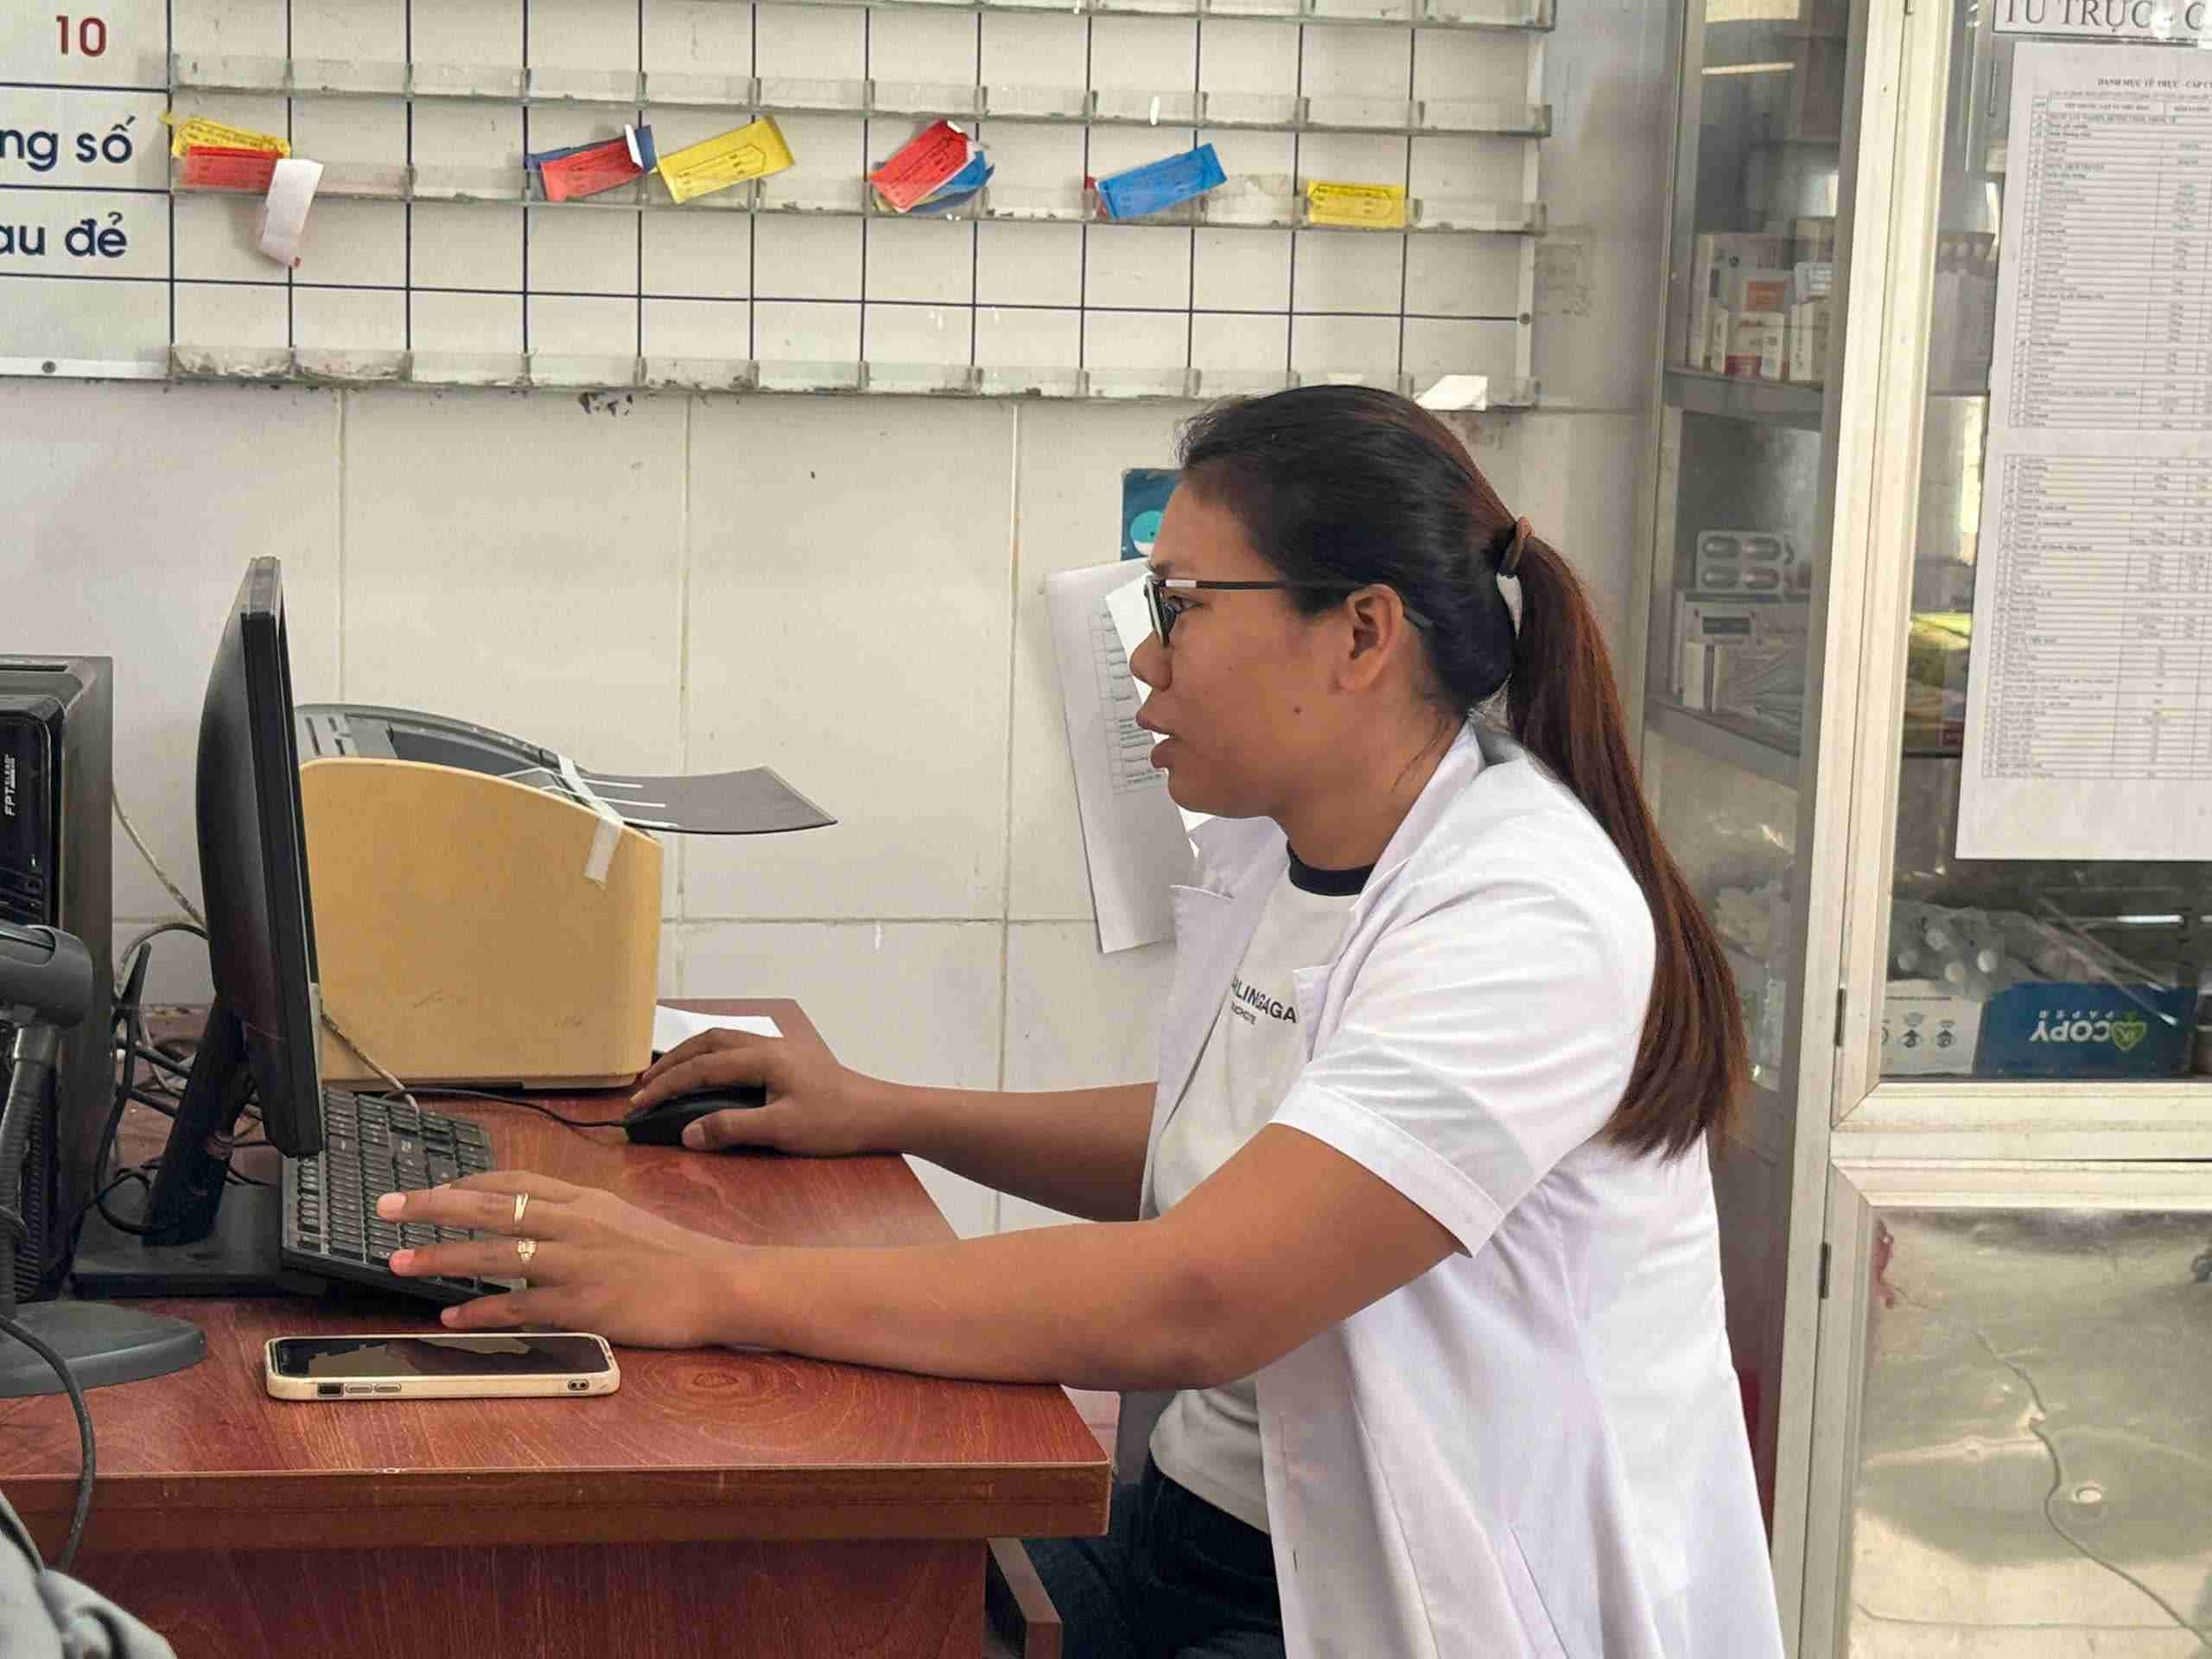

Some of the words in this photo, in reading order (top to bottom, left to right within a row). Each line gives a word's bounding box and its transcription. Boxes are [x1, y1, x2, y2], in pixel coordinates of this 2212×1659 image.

[55, 15, 107, 56] 10
[0, 130, 59, 172] ng
[76, 115, 137, 164] số
[65, 211, 129, 258] đẻ
[4, 786, 16, 817] FPT
[2029, 1020, 2111, 1043] COPY
